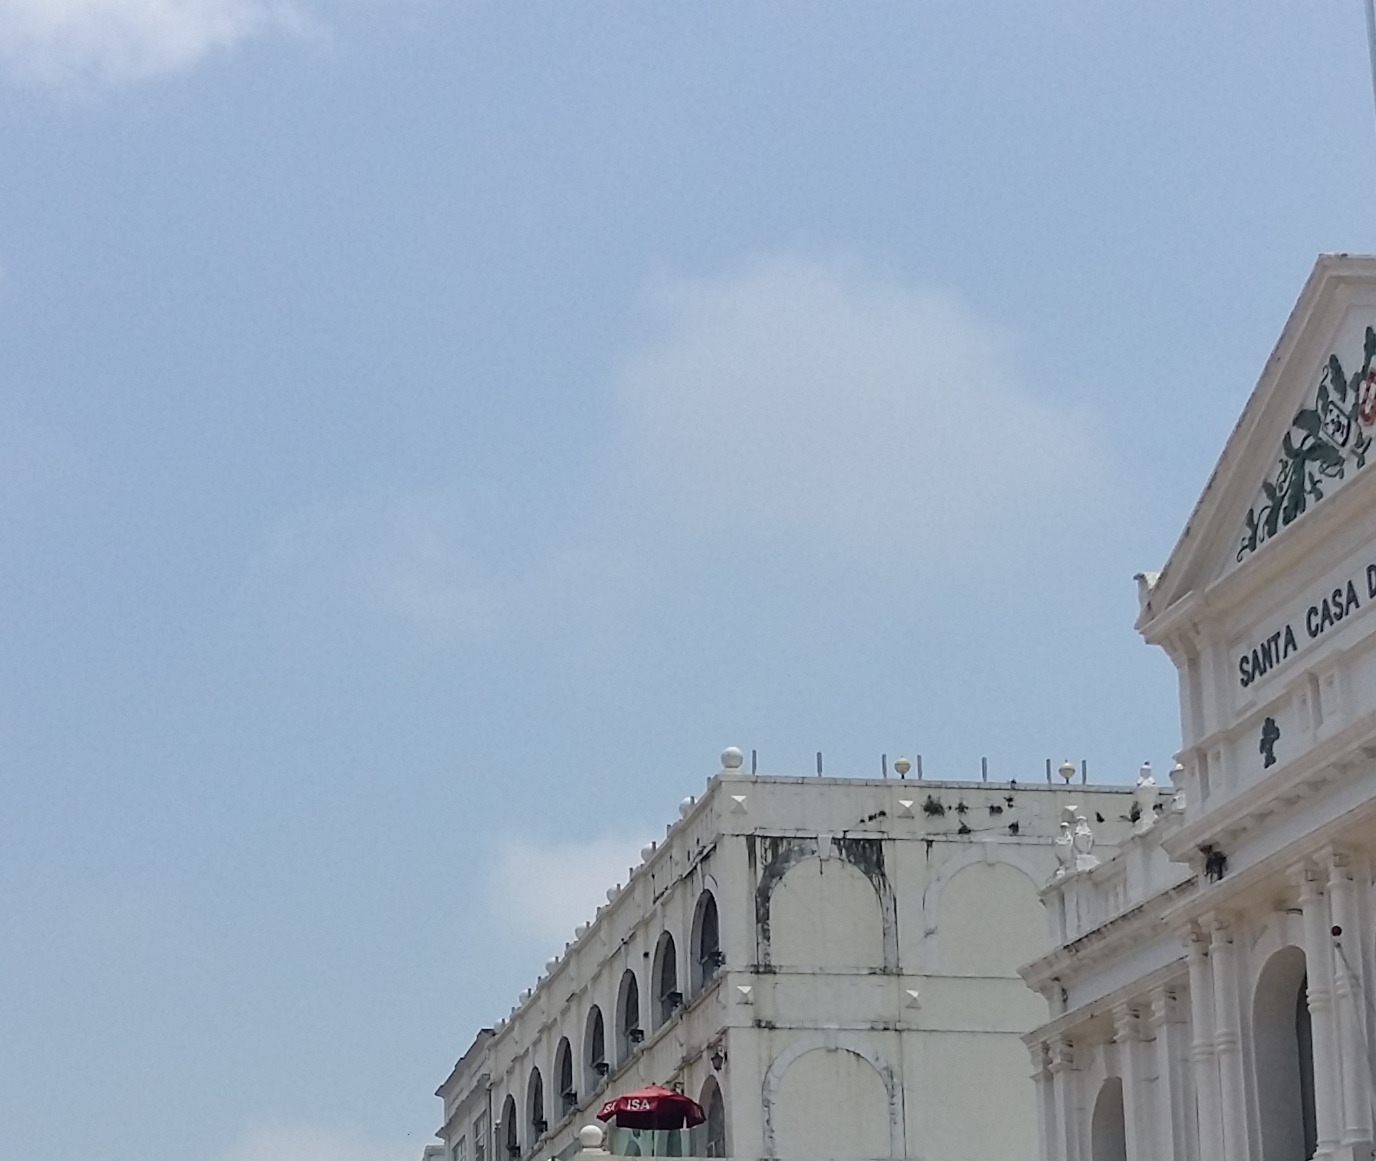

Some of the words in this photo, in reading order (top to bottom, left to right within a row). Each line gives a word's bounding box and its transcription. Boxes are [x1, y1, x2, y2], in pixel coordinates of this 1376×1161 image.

[1238, 624, 1298, 688] SANTA
[1305, 579, 1361, 639] CASA
[627, 1099, 650, 1110] ISA
